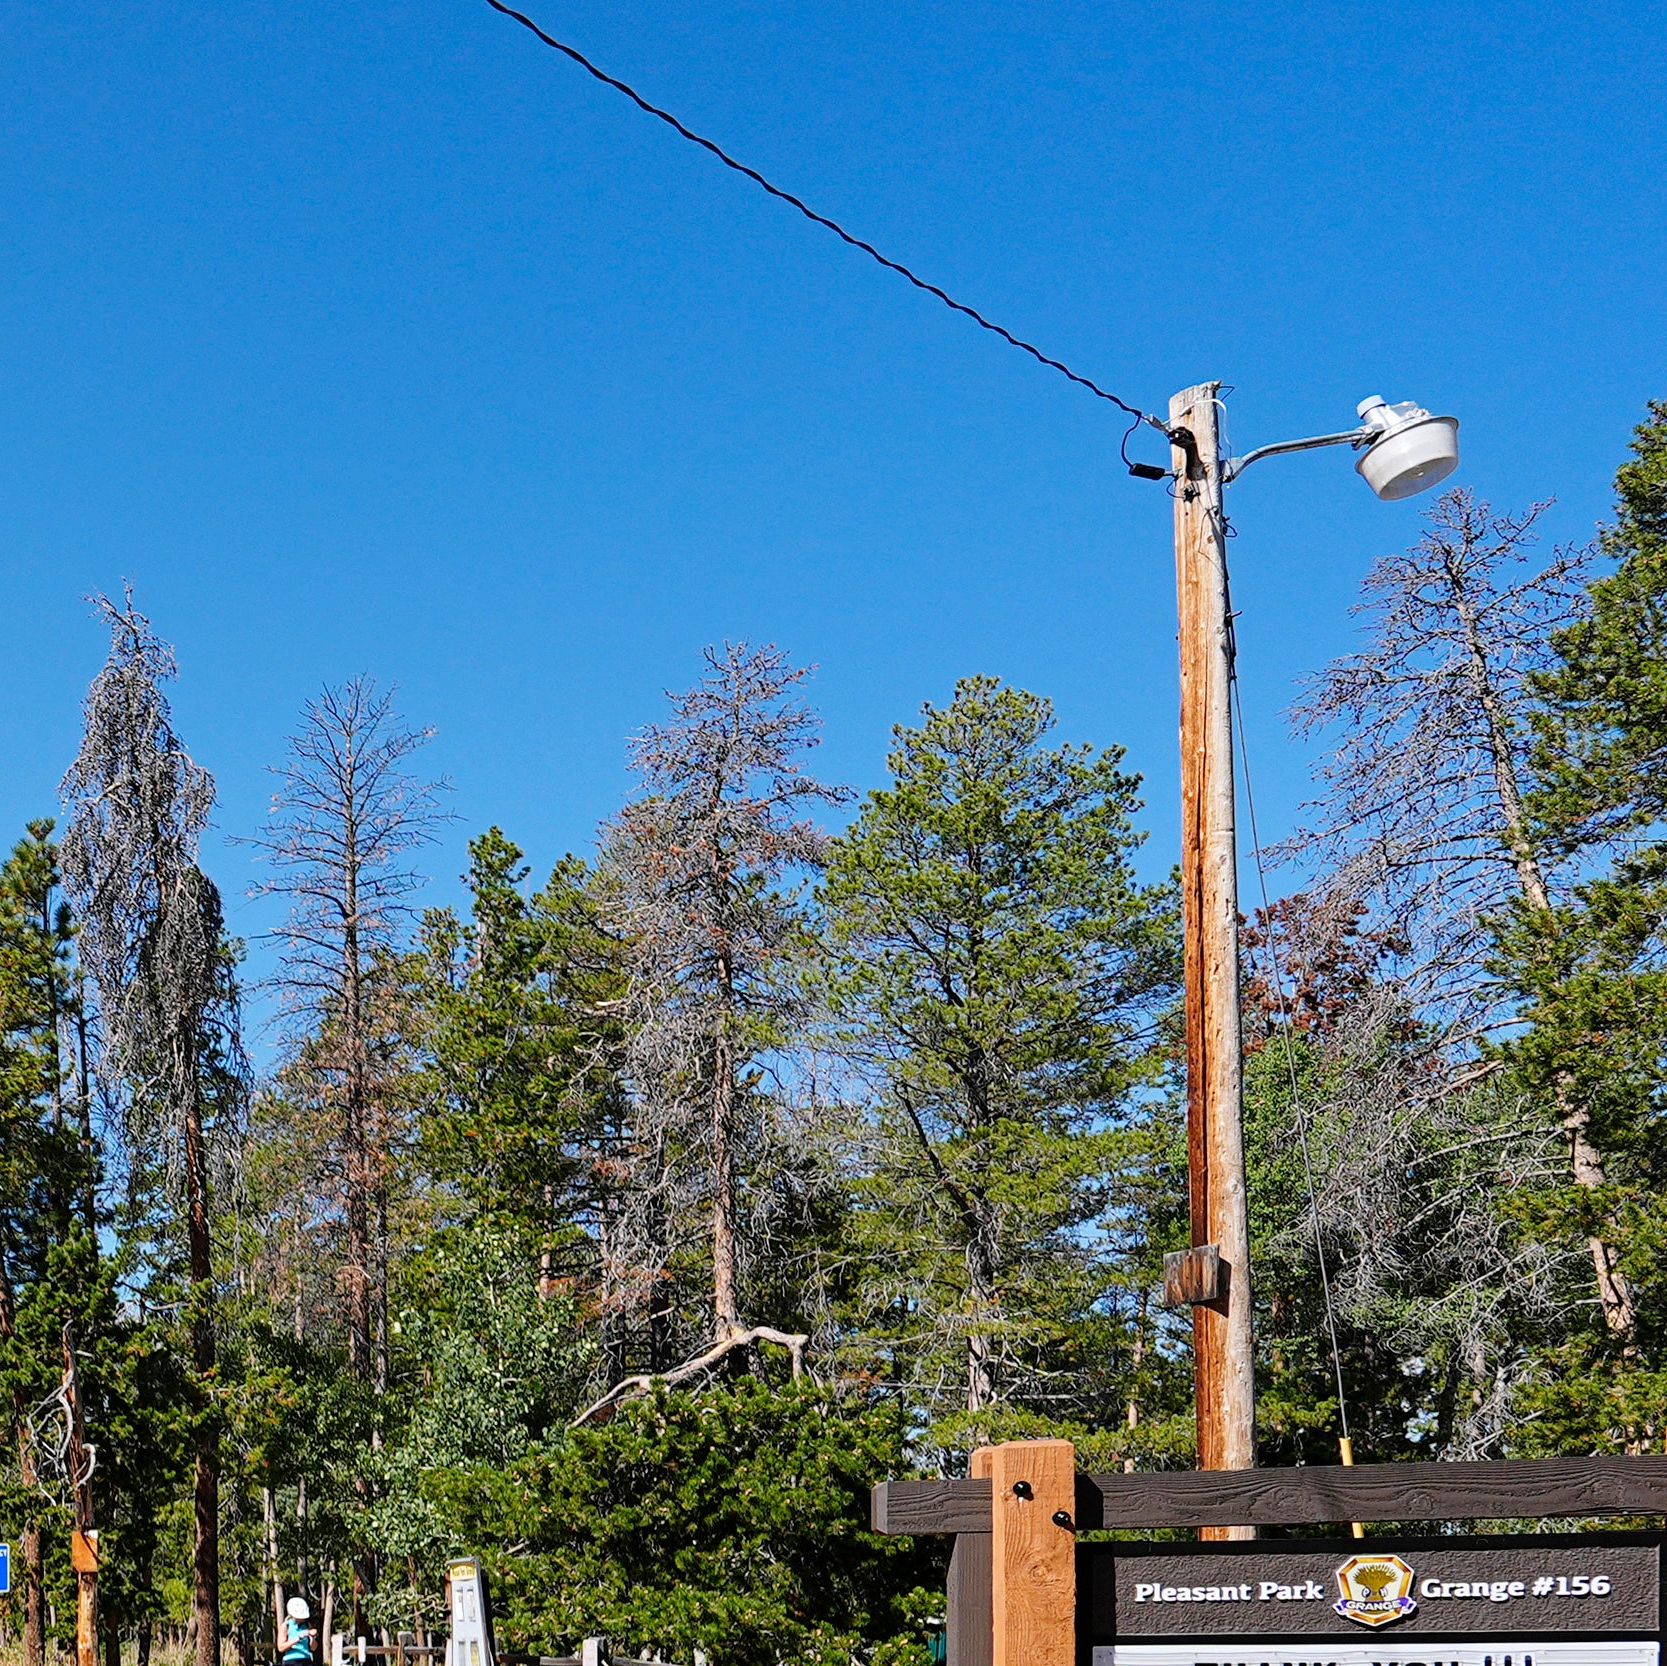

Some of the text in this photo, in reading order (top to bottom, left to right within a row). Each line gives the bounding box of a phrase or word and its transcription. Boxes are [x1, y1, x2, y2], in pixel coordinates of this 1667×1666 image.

[1134, 1575, 1611, 1602] Pleasant Park Grange #156
[1346, 1600, 1401, 1611] GRANGE
